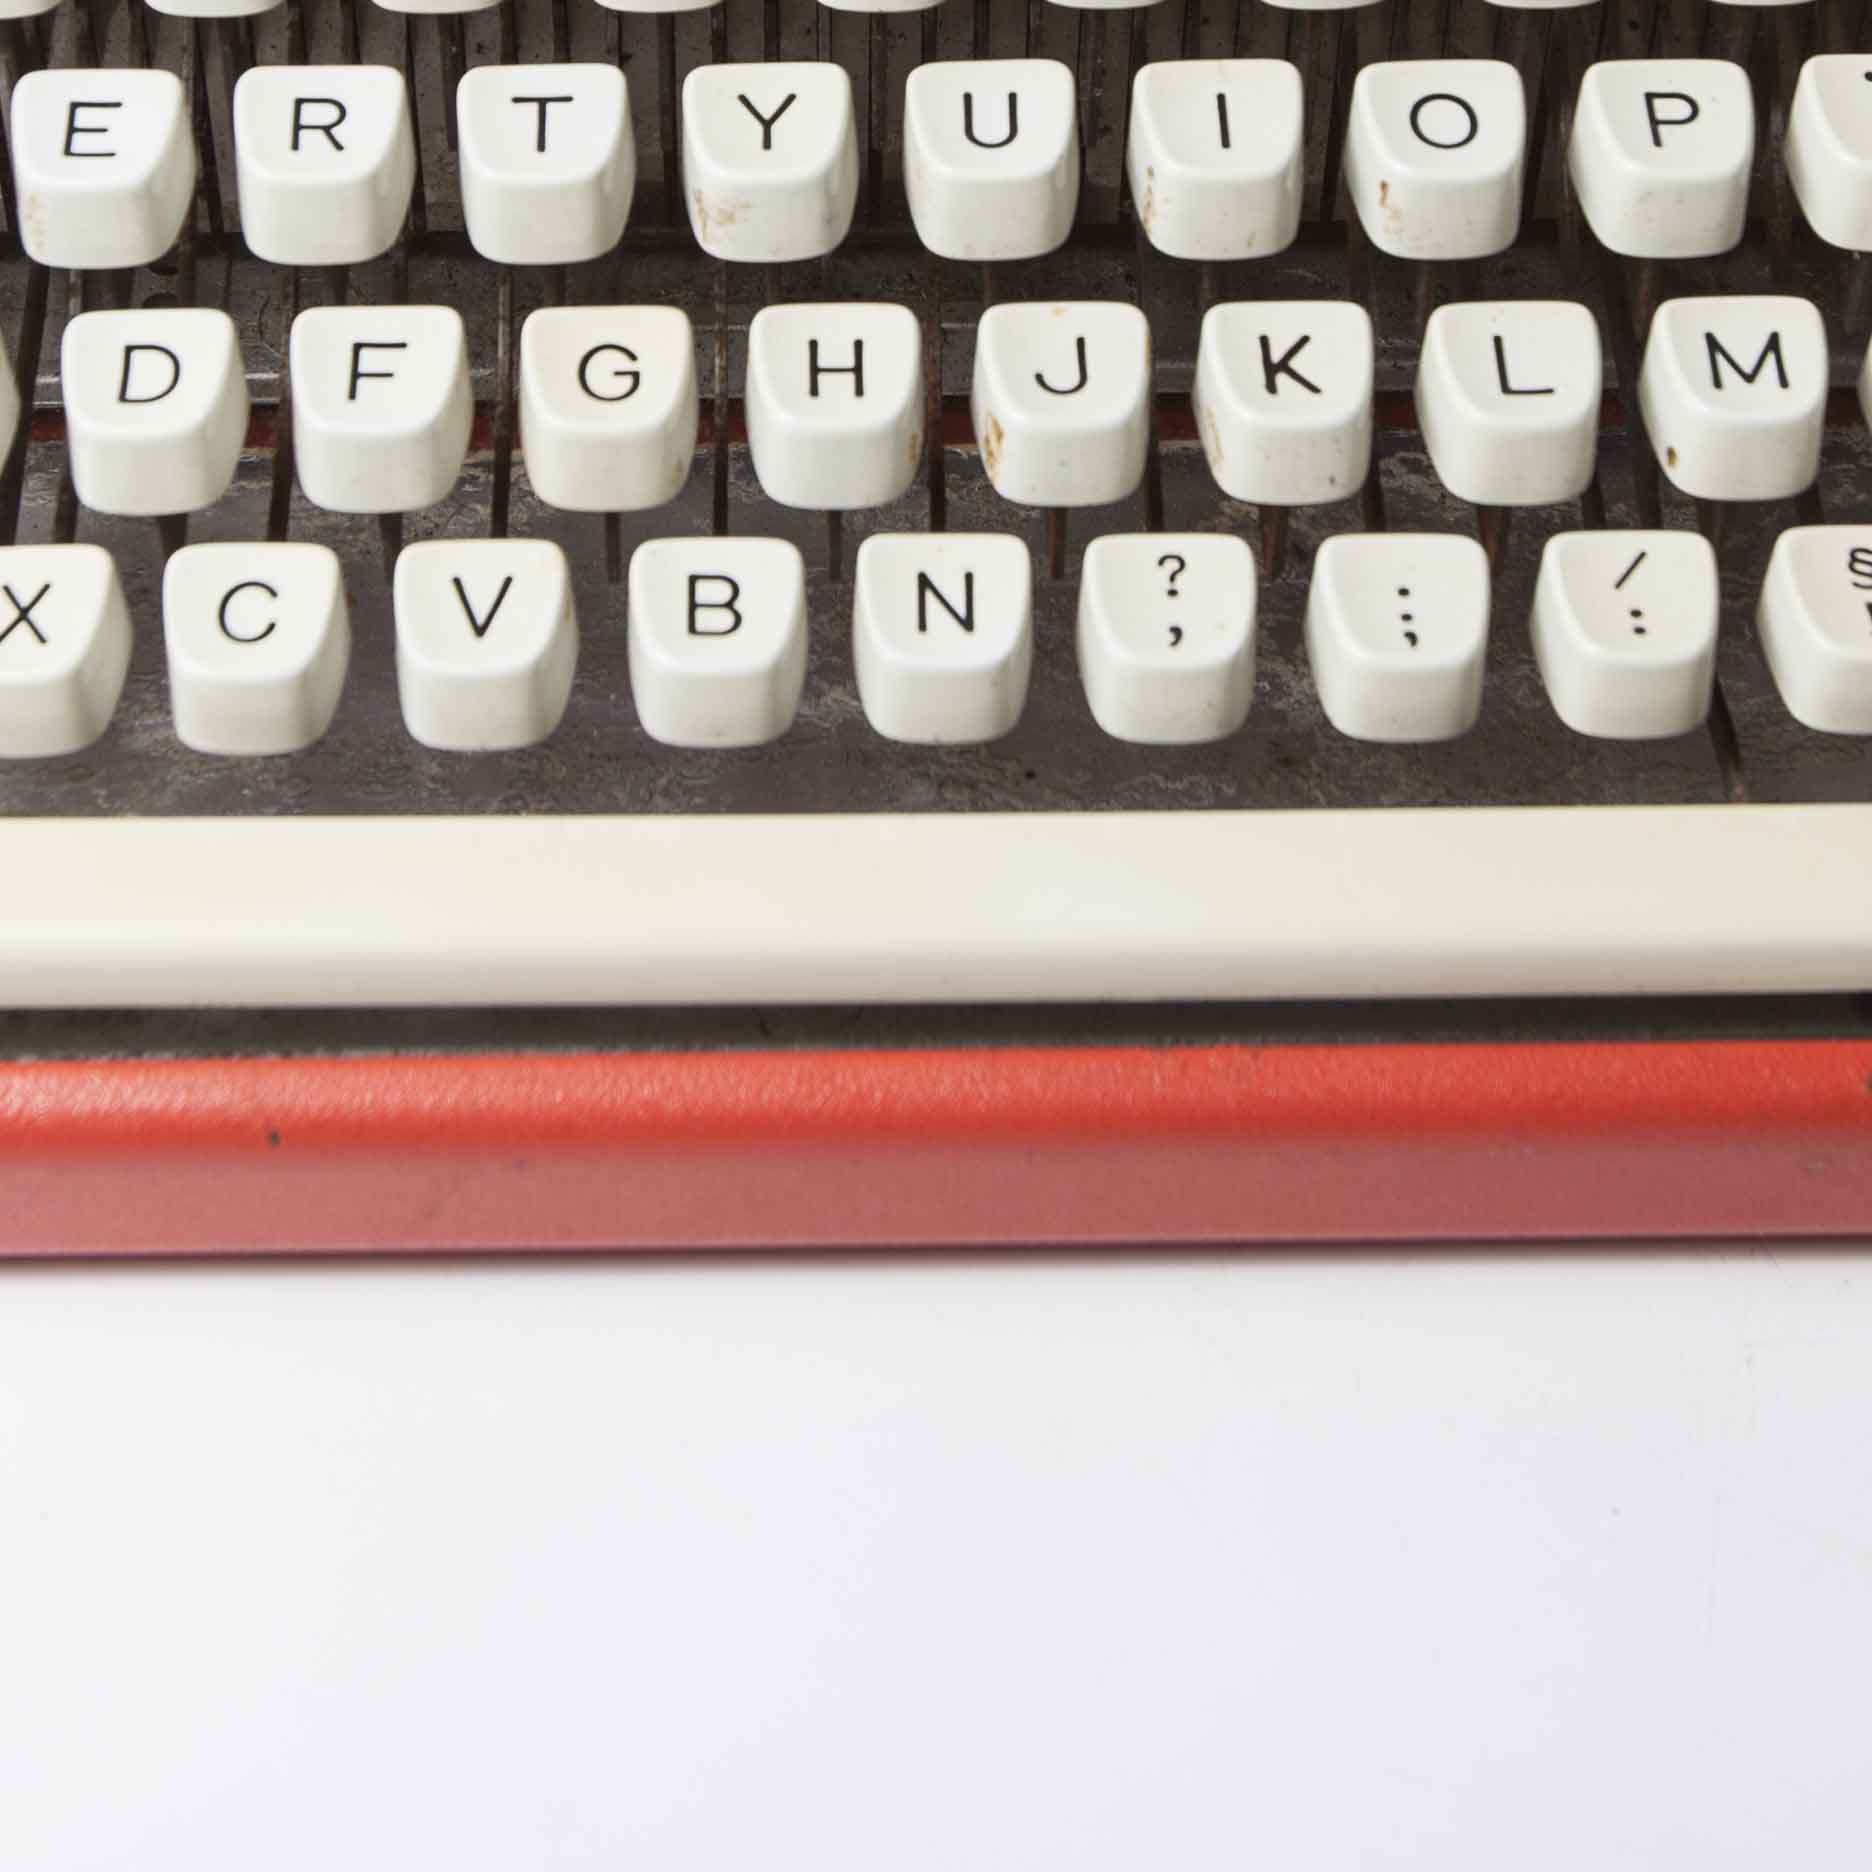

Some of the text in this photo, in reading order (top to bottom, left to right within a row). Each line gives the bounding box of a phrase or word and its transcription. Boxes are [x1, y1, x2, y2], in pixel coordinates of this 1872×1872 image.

[63, 101, 123, 158] E
[290, 97, 347, 152] R
[511, 95, 574, 153] T
[737, 93, 797, 151] Y
[962, 91, 1019, 149] U
[1216, 92, 1231, 150] I
[1409, 92, 1479, 150] O
[1643, 91, 1700, 148] P
[117, 344, 181, 404] D
[347, 341, 408, 401] F
[577, 343, 641, 403] G
[808, 338, 865, 398] H
[1034, 336, 1088, 396] J
[1258, 334, 1322, 396] K
[1492, 335, 1555, 396] L
[1704, 331, 1790, 390] M
[687, 573, 743, 637] B
[917, 571, 975, 633] N
[1157, 554, 1187, 598] ?
[217, 580, 279, 644] C
[452, 575, 513, 639] V
